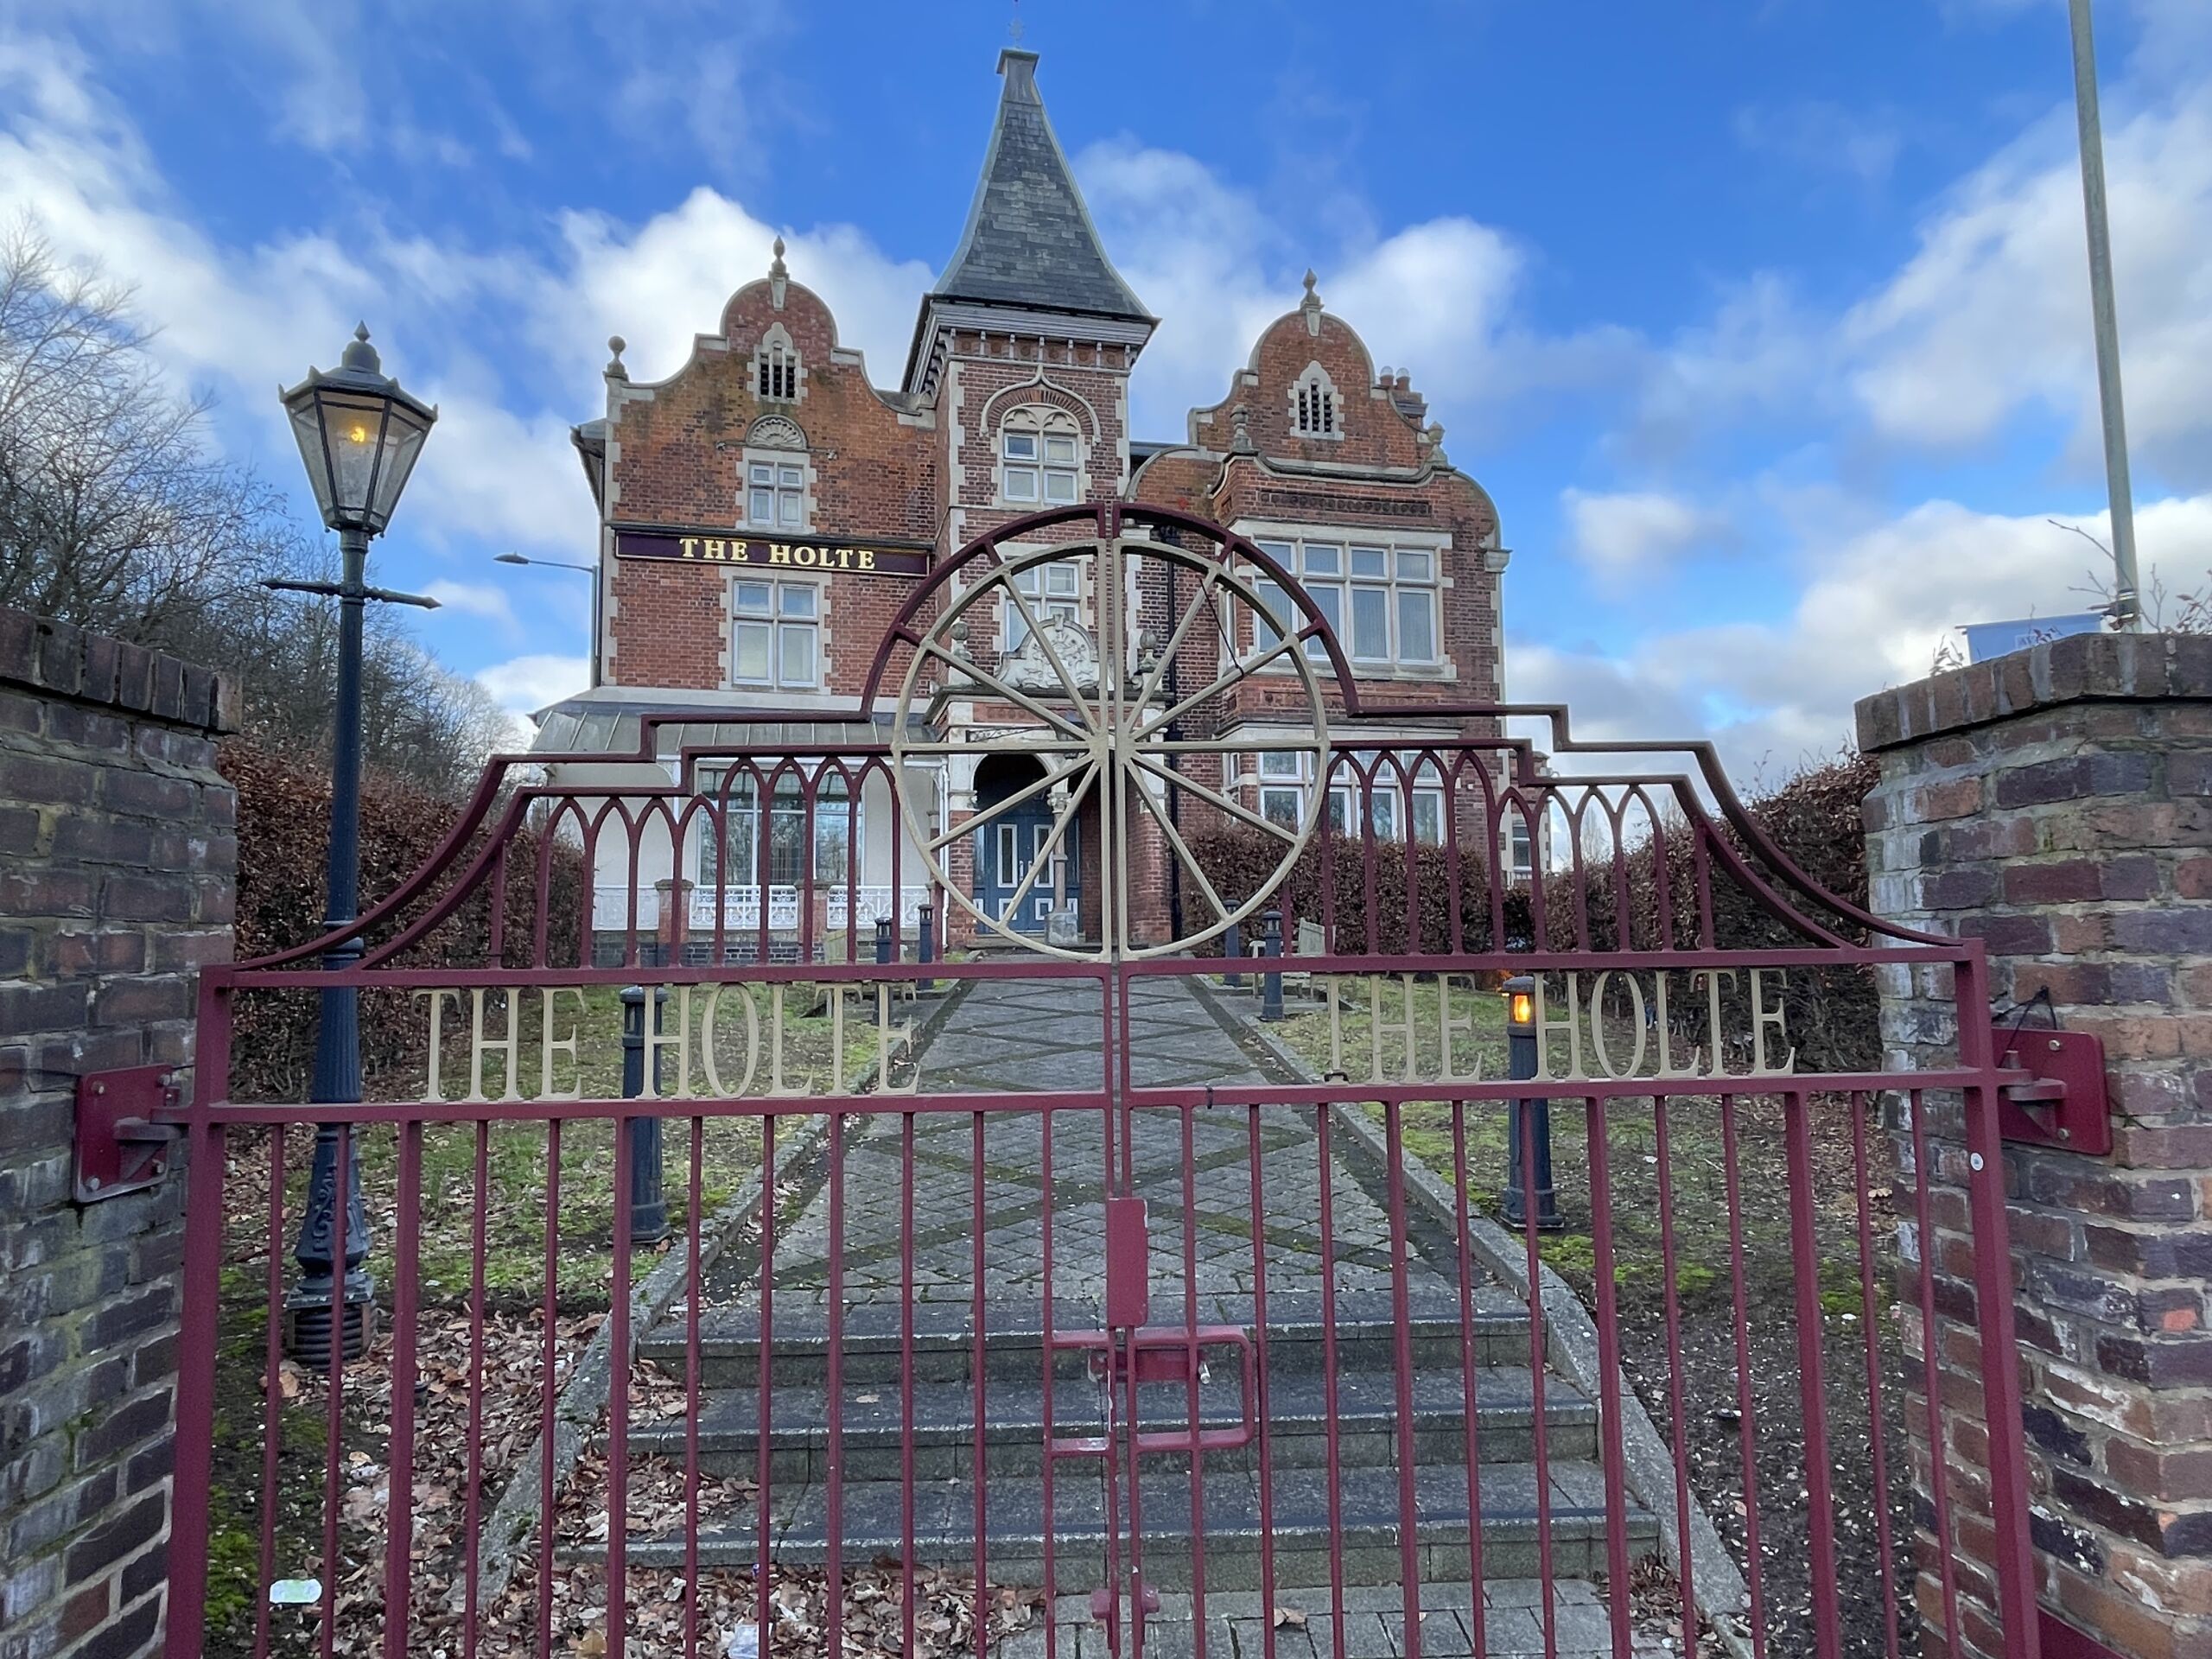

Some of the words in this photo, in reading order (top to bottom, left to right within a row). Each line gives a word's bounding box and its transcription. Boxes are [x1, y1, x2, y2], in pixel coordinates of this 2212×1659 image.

[679, 538, 748, 561] THE
[769, 544, 875, 569] HOLTE
[411, 986, 588, 1103] THE
[634, 982, 921, 1101] HOLTE
[1313, 971, 1483, 1085] THE
[1531, 968, 1796, 1082] HOLTE
